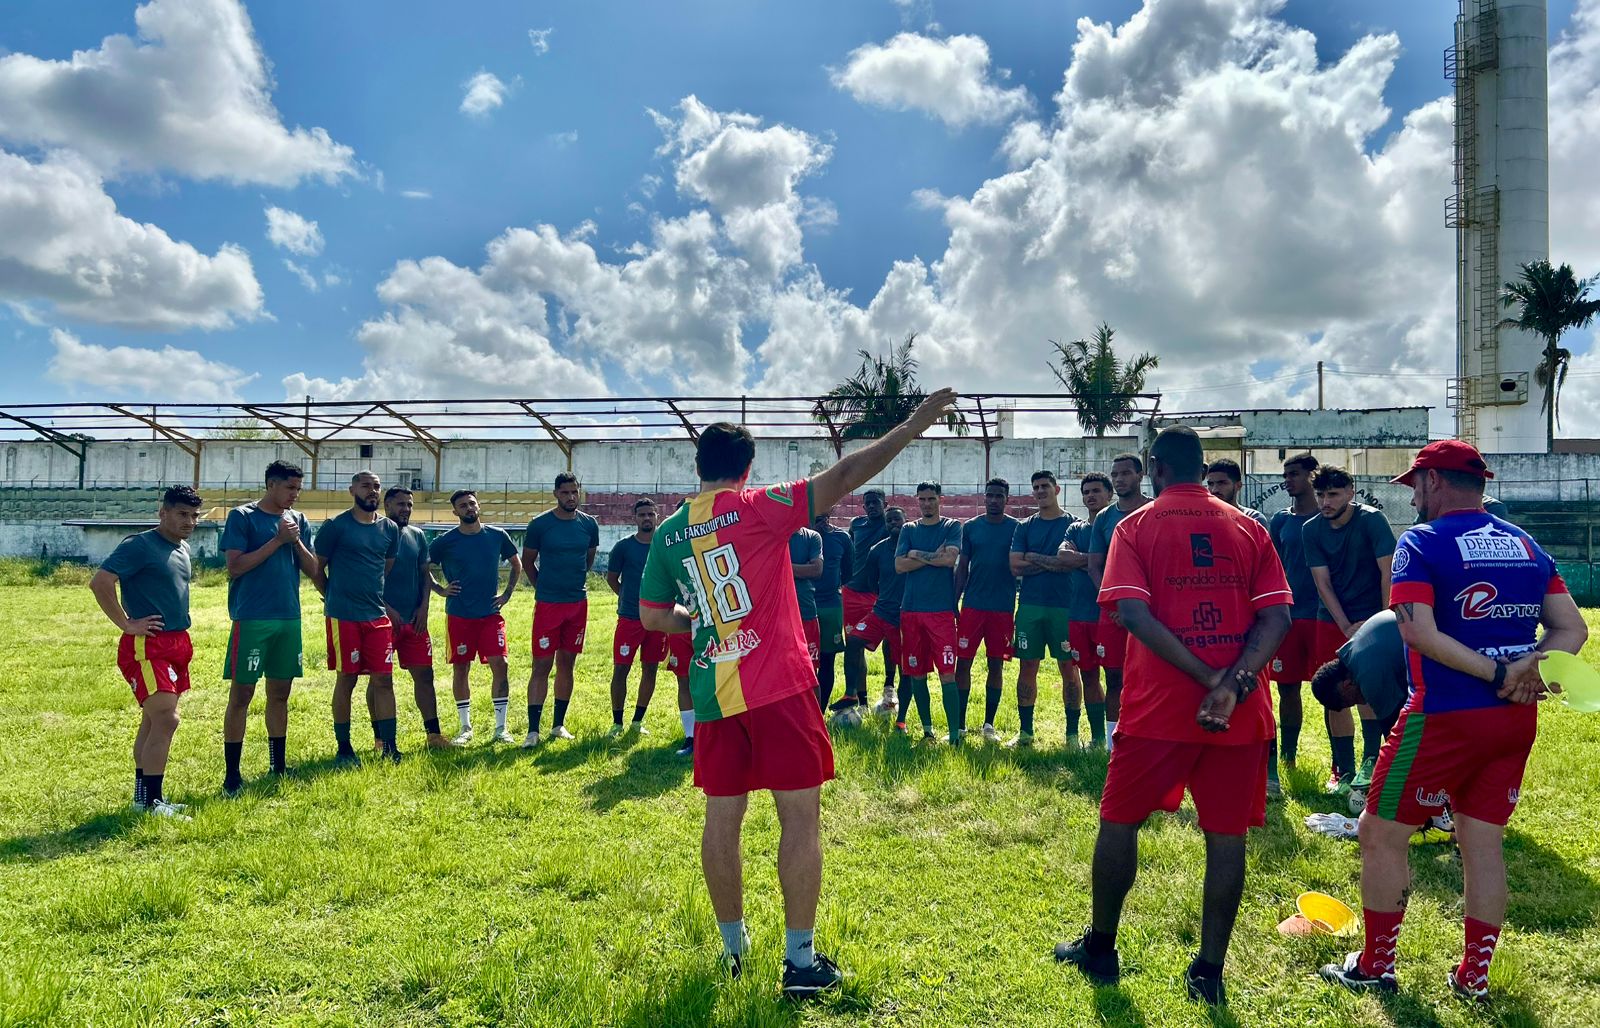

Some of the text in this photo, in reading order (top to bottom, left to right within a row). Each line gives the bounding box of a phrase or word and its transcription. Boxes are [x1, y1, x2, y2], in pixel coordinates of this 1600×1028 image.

[665, 510, 740, 547] G. A. FARROUPILHA
[1464, 538, 1520, 550] DEFESA
[1468, 550, 1524, 559] ESPETACULAR
[682, 542, 753, 627] 18
[497, 635, 505, 648] 5
[1017, 637, 1028, 650] 18
[247, 656, 260, 671] 19
[942, 651, 955, 665] 13
